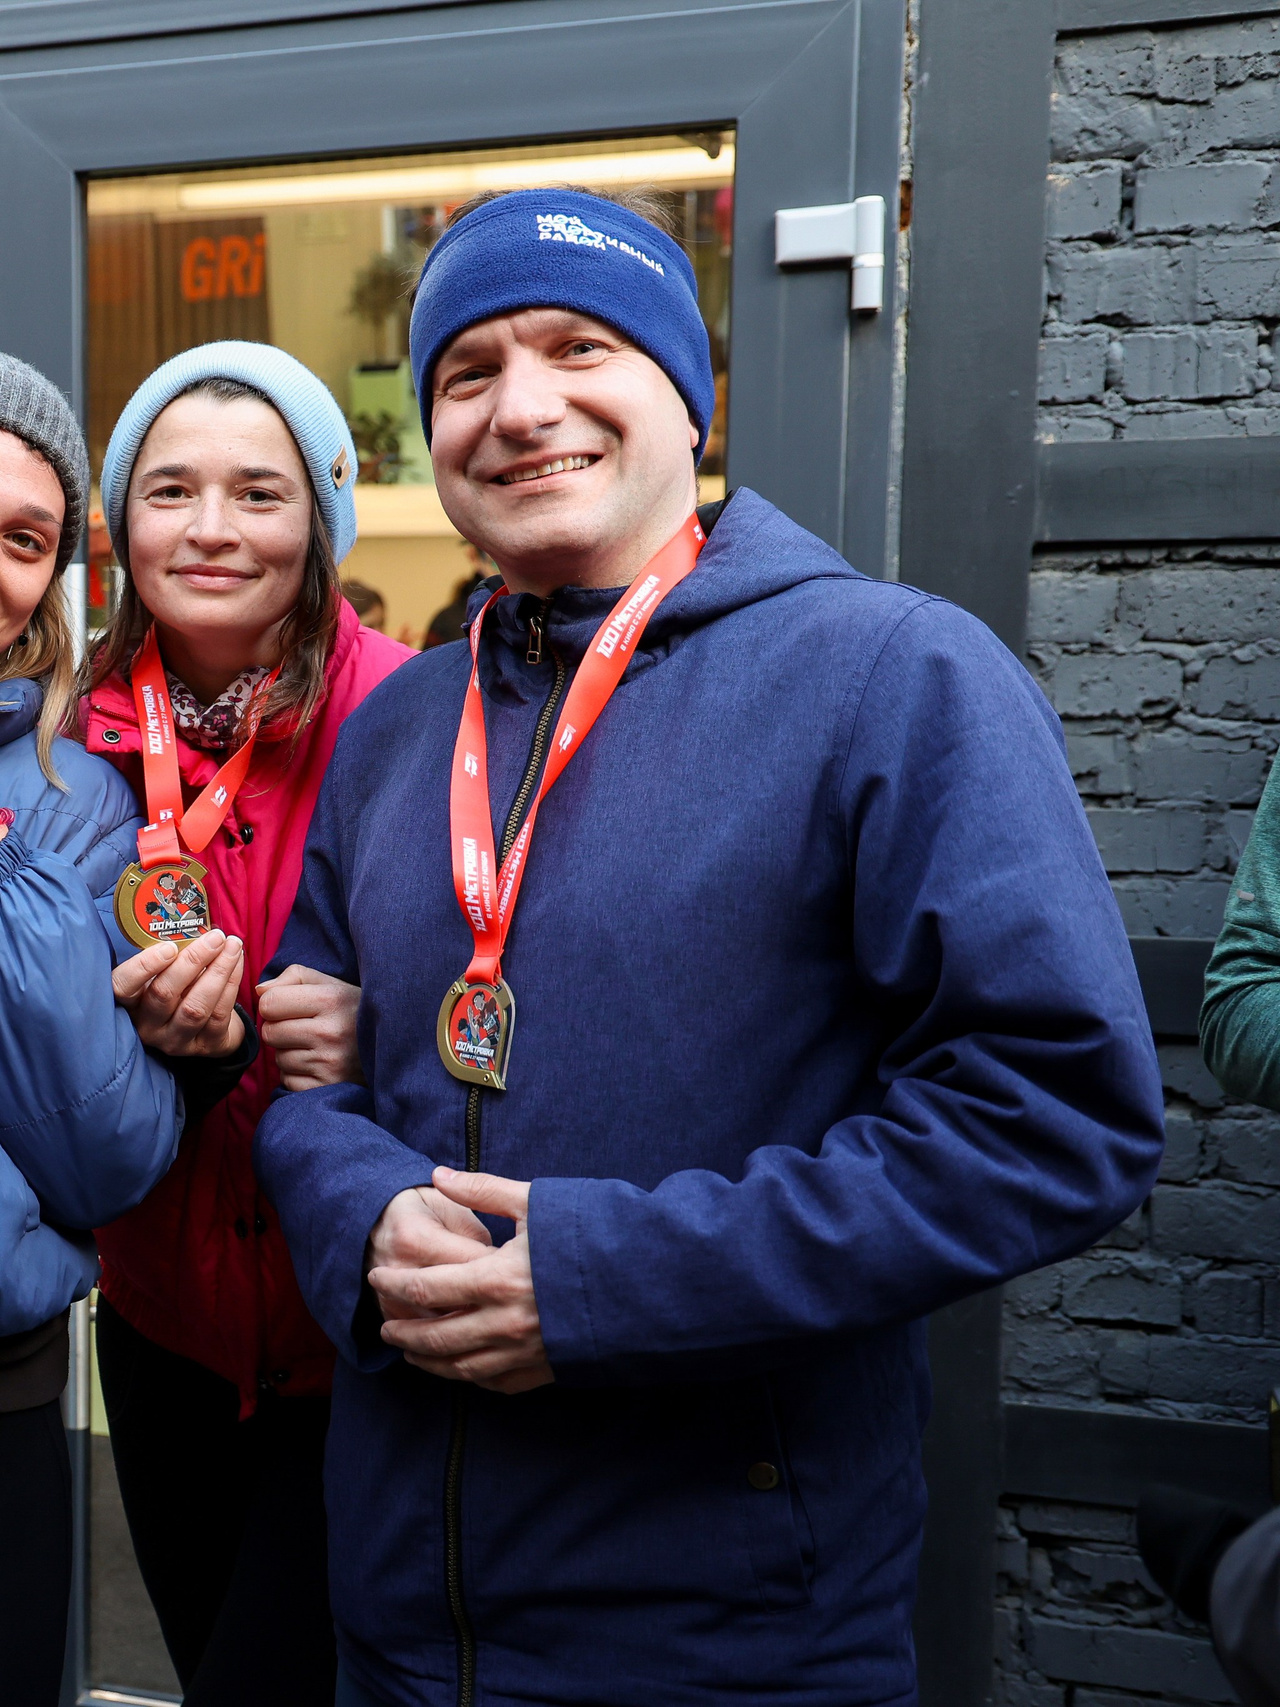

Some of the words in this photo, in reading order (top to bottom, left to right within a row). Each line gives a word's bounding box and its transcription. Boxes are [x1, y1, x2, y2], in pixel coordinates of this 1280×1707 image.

[596, 626, 620, 659] 100
[610, 574, 660, 632] МЕТРОВКА
[620, 643, 626, 652] В
[623, 625, 636, 645] КИНО
[632, 618, 638, 626] С
[635, 609, 644, 620] 27
[141, 684, 160, 732] МЕТРОВКА
[148, 732, 163, 754] 100
[517, 821, 530, 850] 100
[463, 837, 480, 904] МЕТРОВКА
[481, 876, 490, 885] 27
[482, 891, 492, 912] КИНО
[149, 921, 165, 931] 100
[164, 917, 204, 930] МЕТРОВКА
[467, 904, 488, 932] 100
